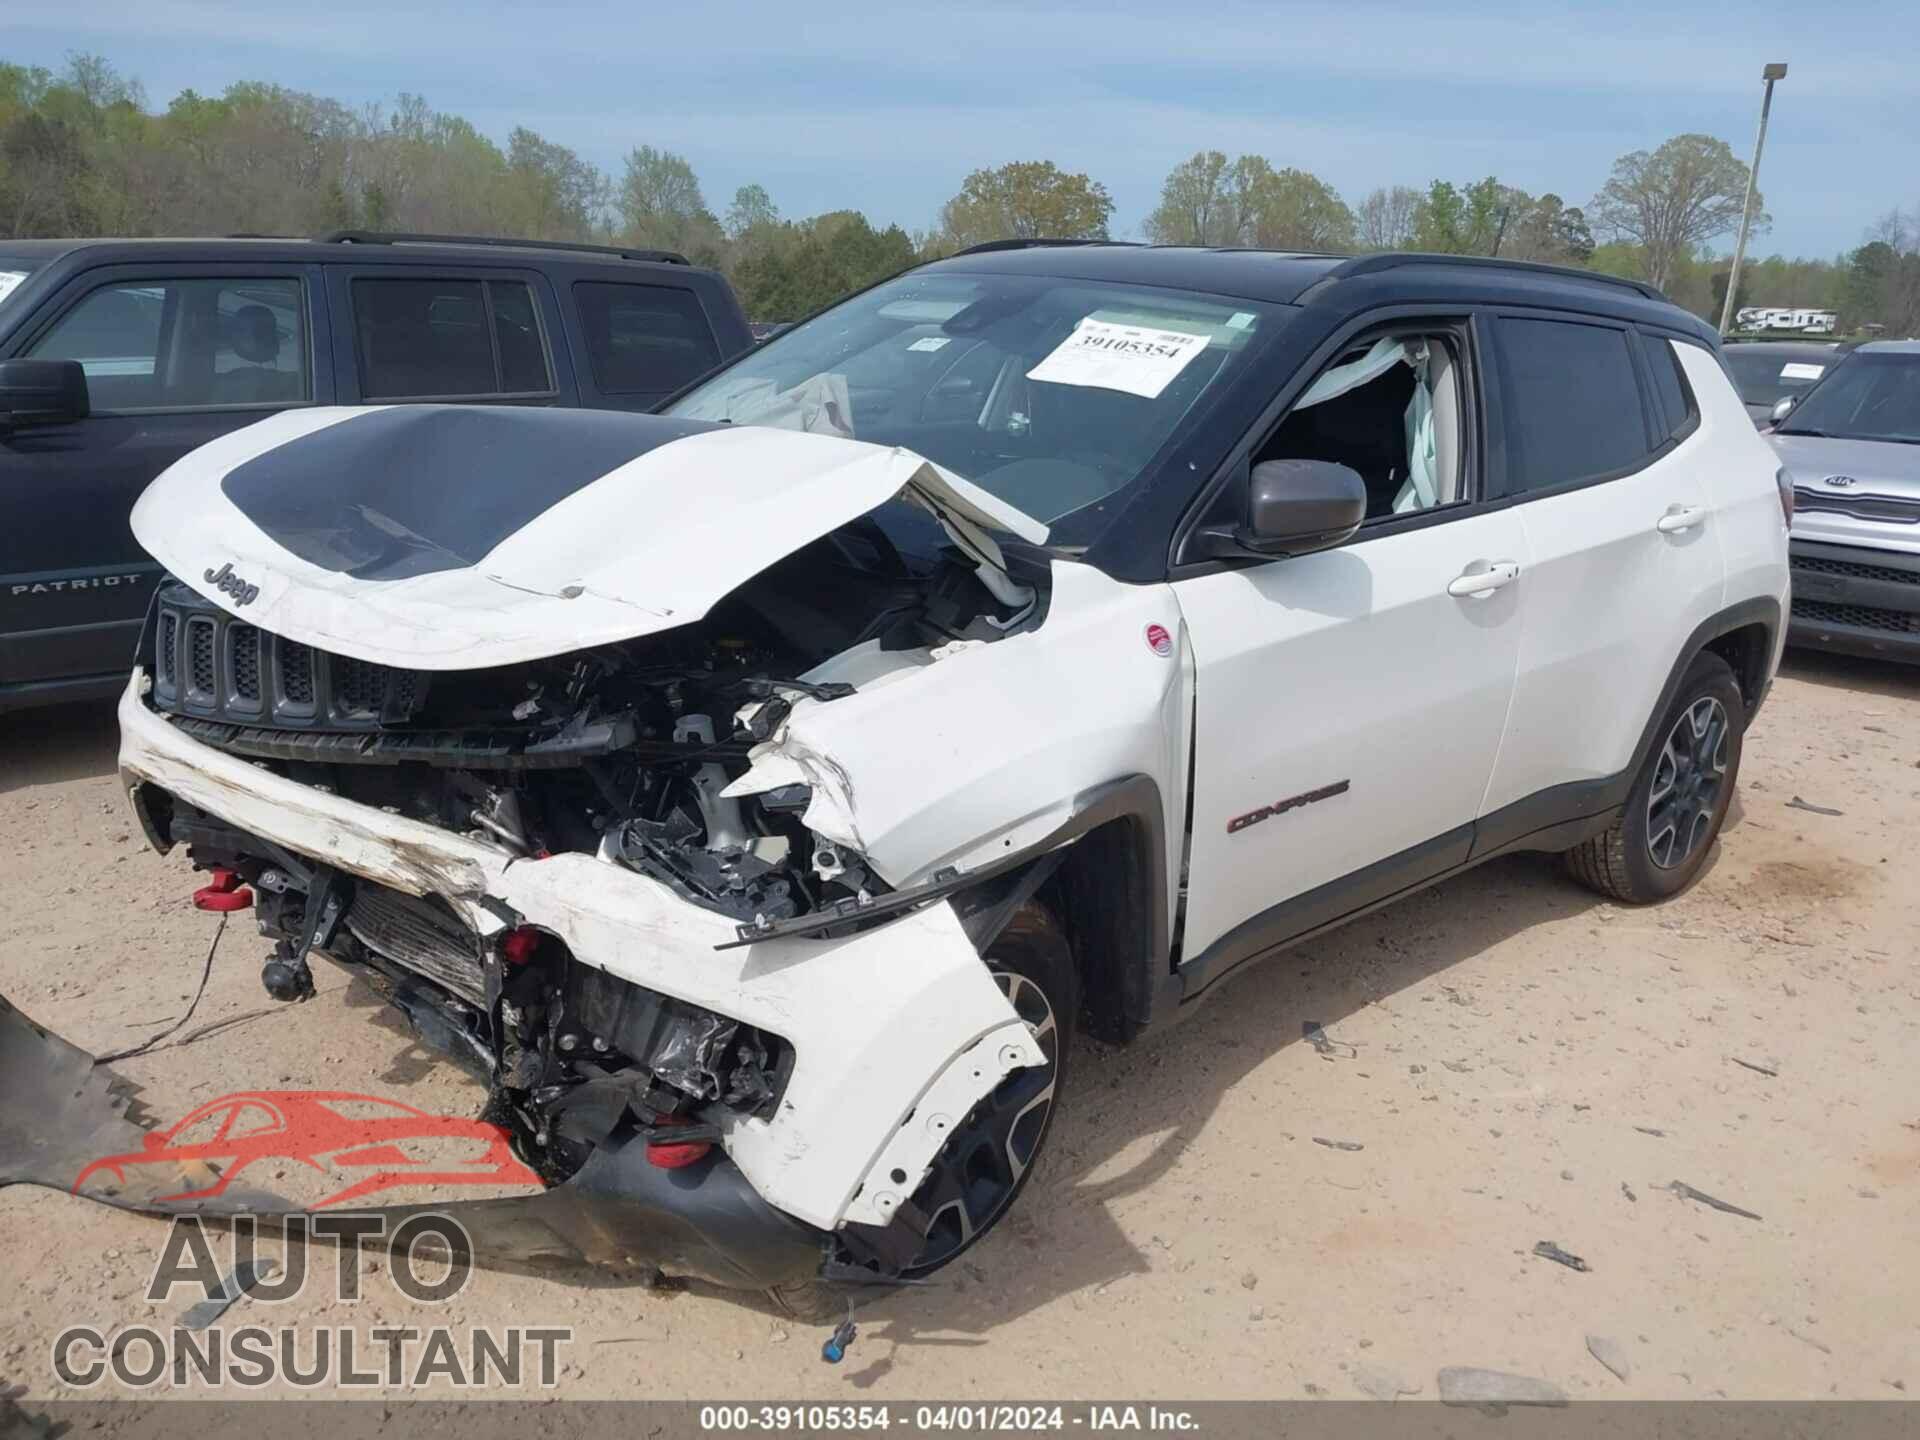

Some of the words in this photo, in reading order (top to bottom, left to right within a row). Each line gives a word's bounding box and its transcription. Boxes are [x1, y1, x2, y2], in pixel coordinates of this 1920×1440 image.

[1074, 335, 1182, 358] 39105354
[11, 574, 141, 596] PATRIOT
[203, 562, 260, 608] Jeep
